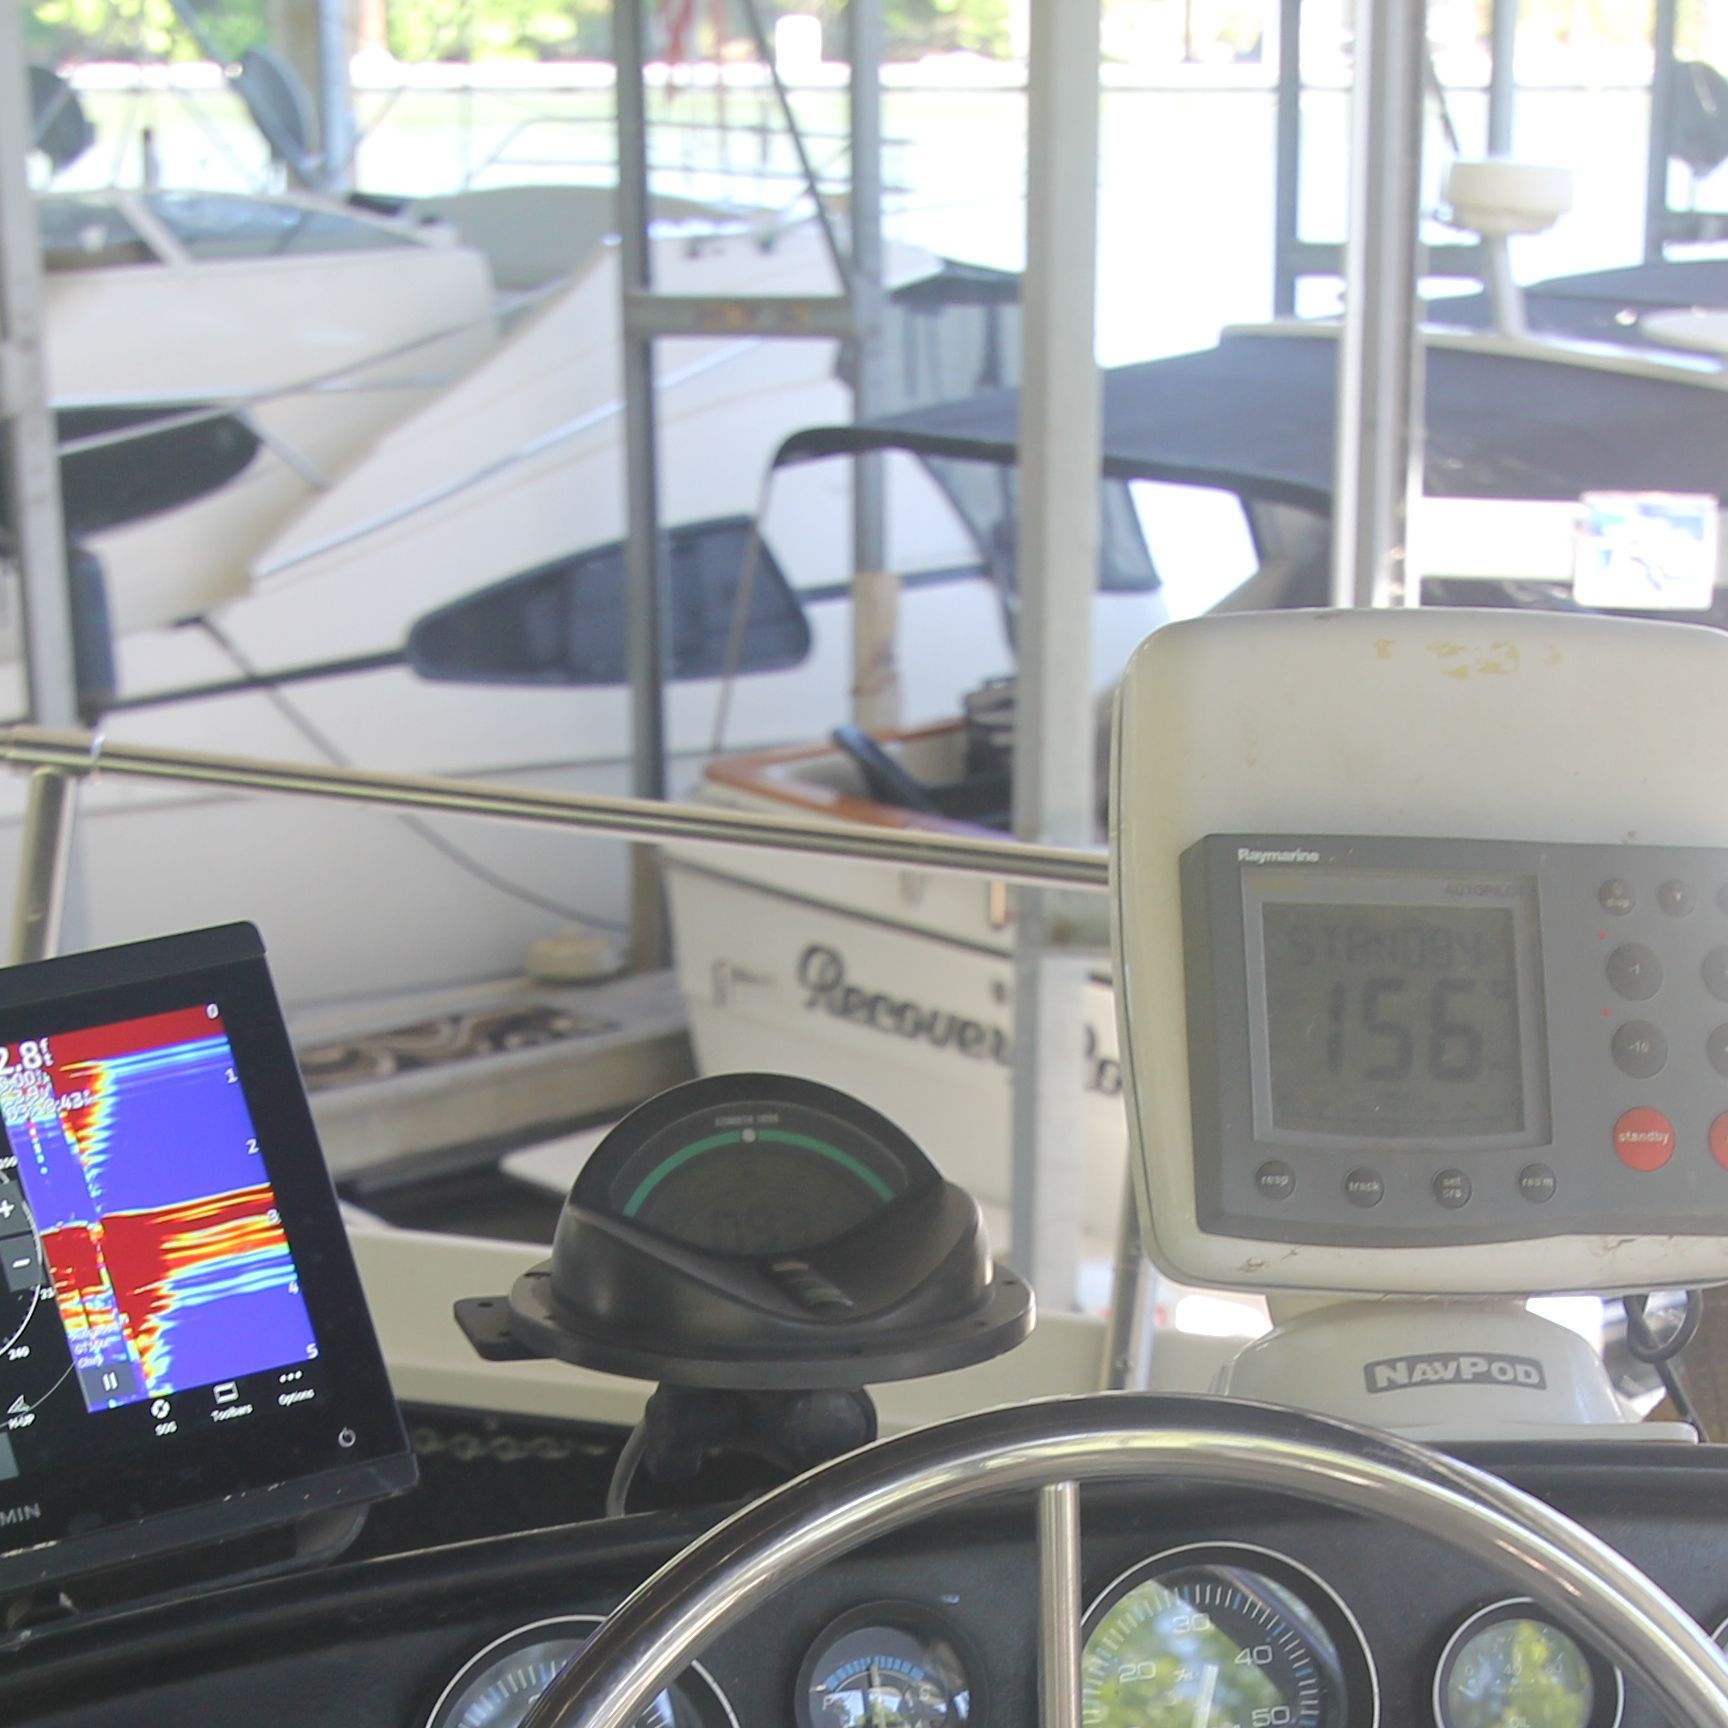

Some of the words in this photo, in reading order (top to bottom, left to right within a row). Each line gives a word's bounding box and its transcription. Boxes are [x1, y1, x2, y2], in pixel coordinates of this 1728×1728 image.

[1238, 848, 1320, 863] Raymarine
[206, 1004, 219, 1020] 0
[1327, 977, 1484, 1082] 156
[225, 1068, 238, 1085] 1
[1618, 1131, 1669, 1146] standby
[246, 1139, 260, 1155] 2
[1348, 1180, 1380, 1192] track
[267, 1209, 281, 1226] 3
[288, 1280, 300, 1296] 4
[306, 1343, 319, 1359] 5
[1172, 1613, 1211, 1634] 30
[1234, 1645, 1273, 1666] 40
[1118, 1661, 1156, 1682] 20
[1251, 1706, 1290, 1728] 50
